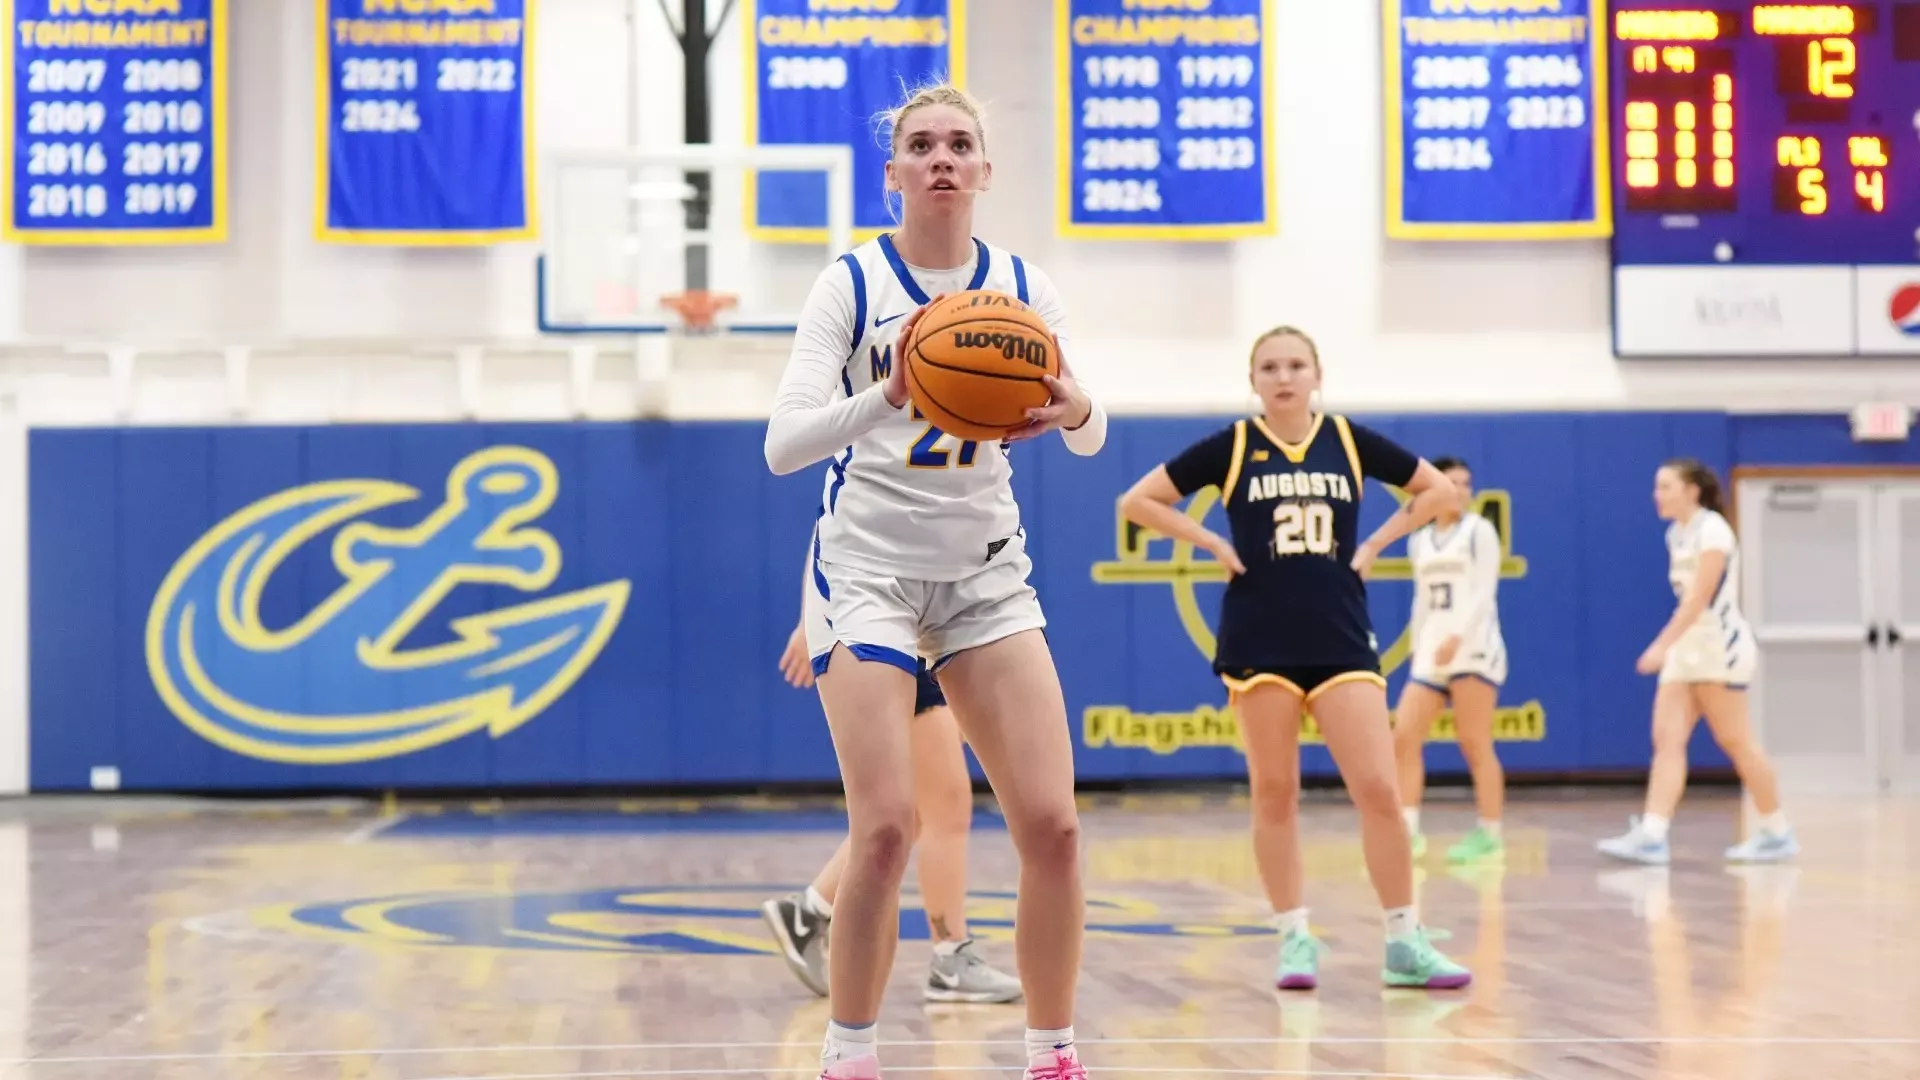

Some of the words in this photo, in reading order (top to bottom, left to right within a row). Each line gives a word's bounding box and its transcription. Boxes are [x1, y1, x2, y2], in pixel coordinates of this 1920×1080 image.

[19, 21, 206, 48] TOURNAMENT
[29, 61, 105, 91] 2007
[344, 60, 416, 89] 2021
[438, 59, 514, 91] 2022
[1179, 56, 1253, 86] 1999
[1809, 38, 1855, 97] 12
[29, 102, 104, 133] 2009
[125, 102, 201, 132] 2010
[344, 101, 419, 131] 2024
[29, 143, 105, 174] 2016
[124, 143, 200, 174] 2017
[1179, 138, 1254, 169] 2023
[30, 185, 105, 215] 2018
[126, 185, 195, 212] 2019
[1085, 180, 1160, 210] 2024
[1798, 169, 1826, 213] 5
[1856, 172, 1883, 210] 4
[954, 332, 1047, 370] Wilson
[1248, 472, 1352, 503] AUGUSTA
[1273, 502, 1334, 555] 20
[1088, 711, 1241, 747] Flagshi
